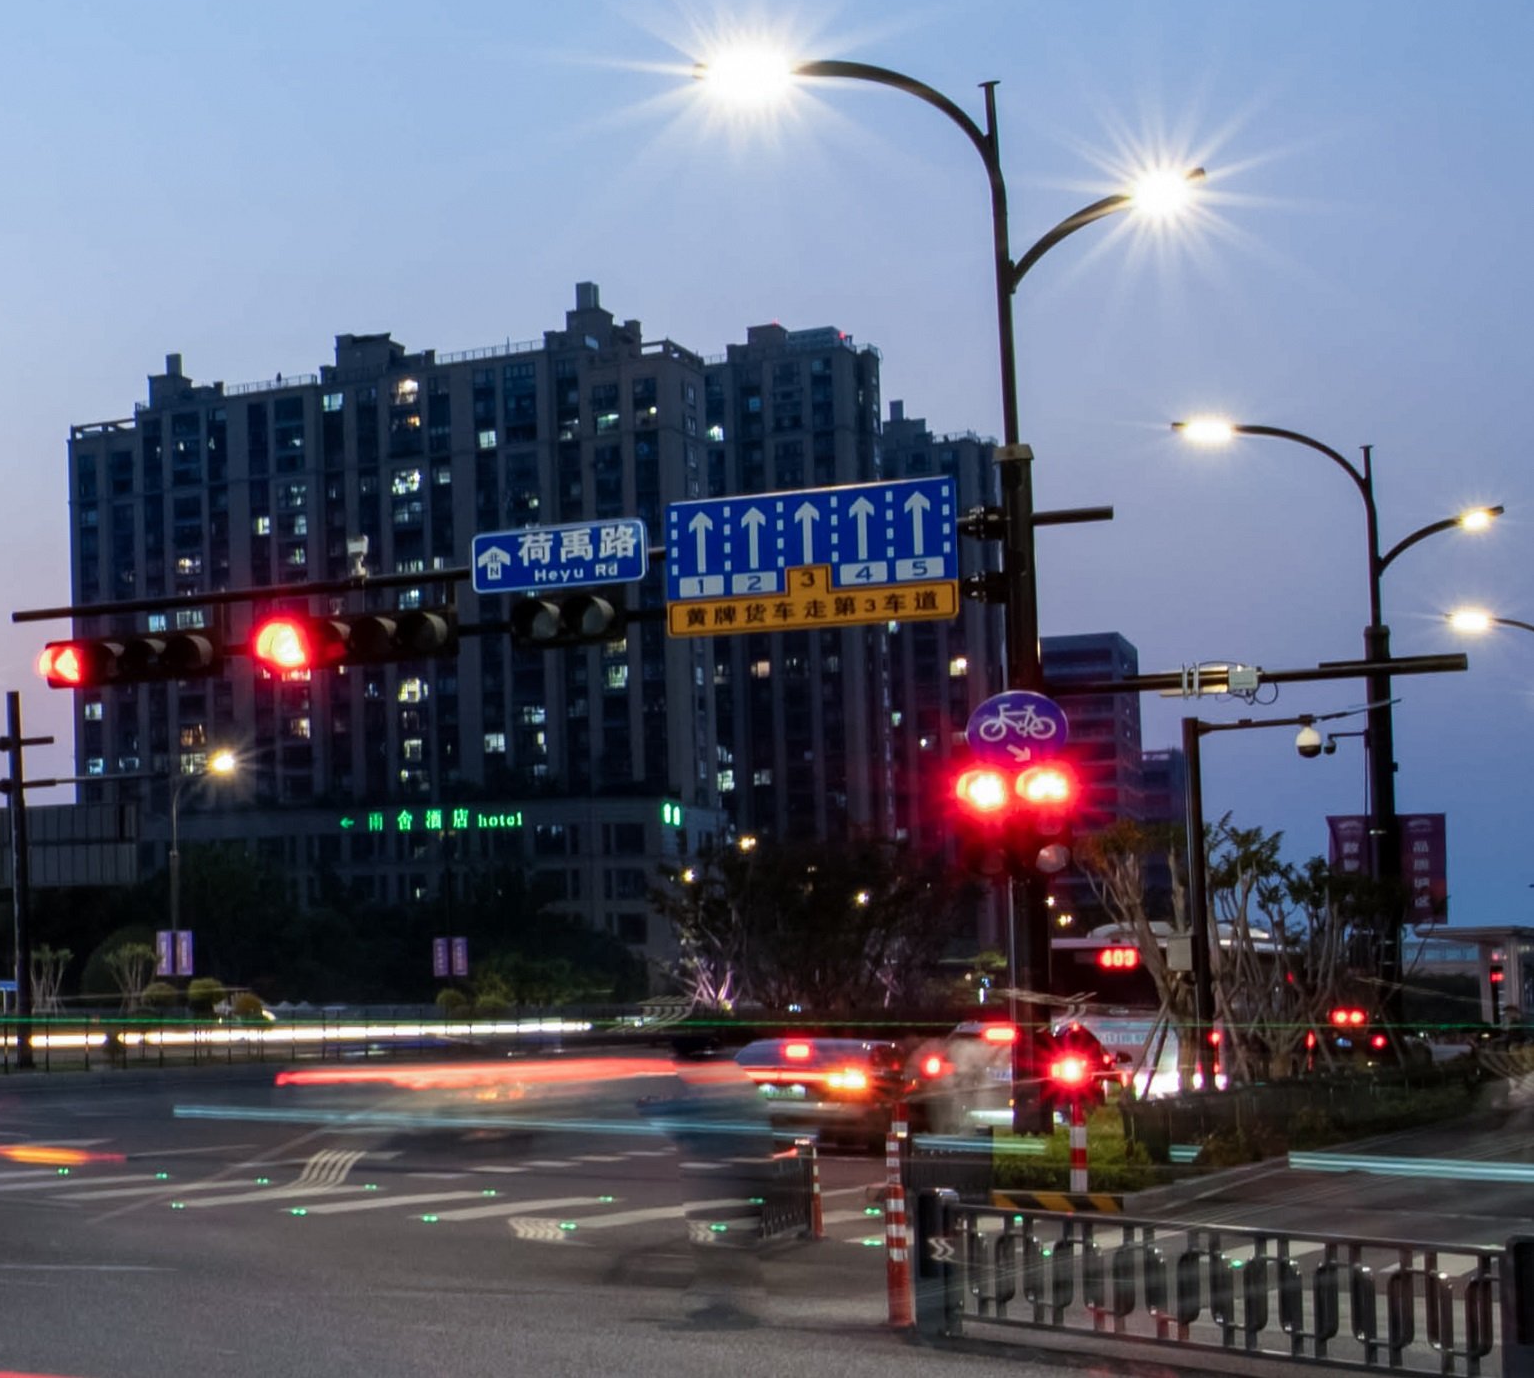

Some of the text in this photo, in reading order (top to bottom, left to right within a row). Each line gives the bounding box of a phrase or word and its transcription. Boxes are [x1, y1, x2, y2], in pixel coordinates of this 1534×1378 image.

[518, 524, 637, 567] 荷禹路
[534, 562, 618, 582] Heyu Rd
[854, 565, 873, 581] 4
[911, 560, 928, 577] 5
[746, 575, 762, 591] 2
[800, 571, 815, 588] 3
[686, 591, 940, 628] 黄牌货车走第3车道
[478, 812, 522, 828] hotel
